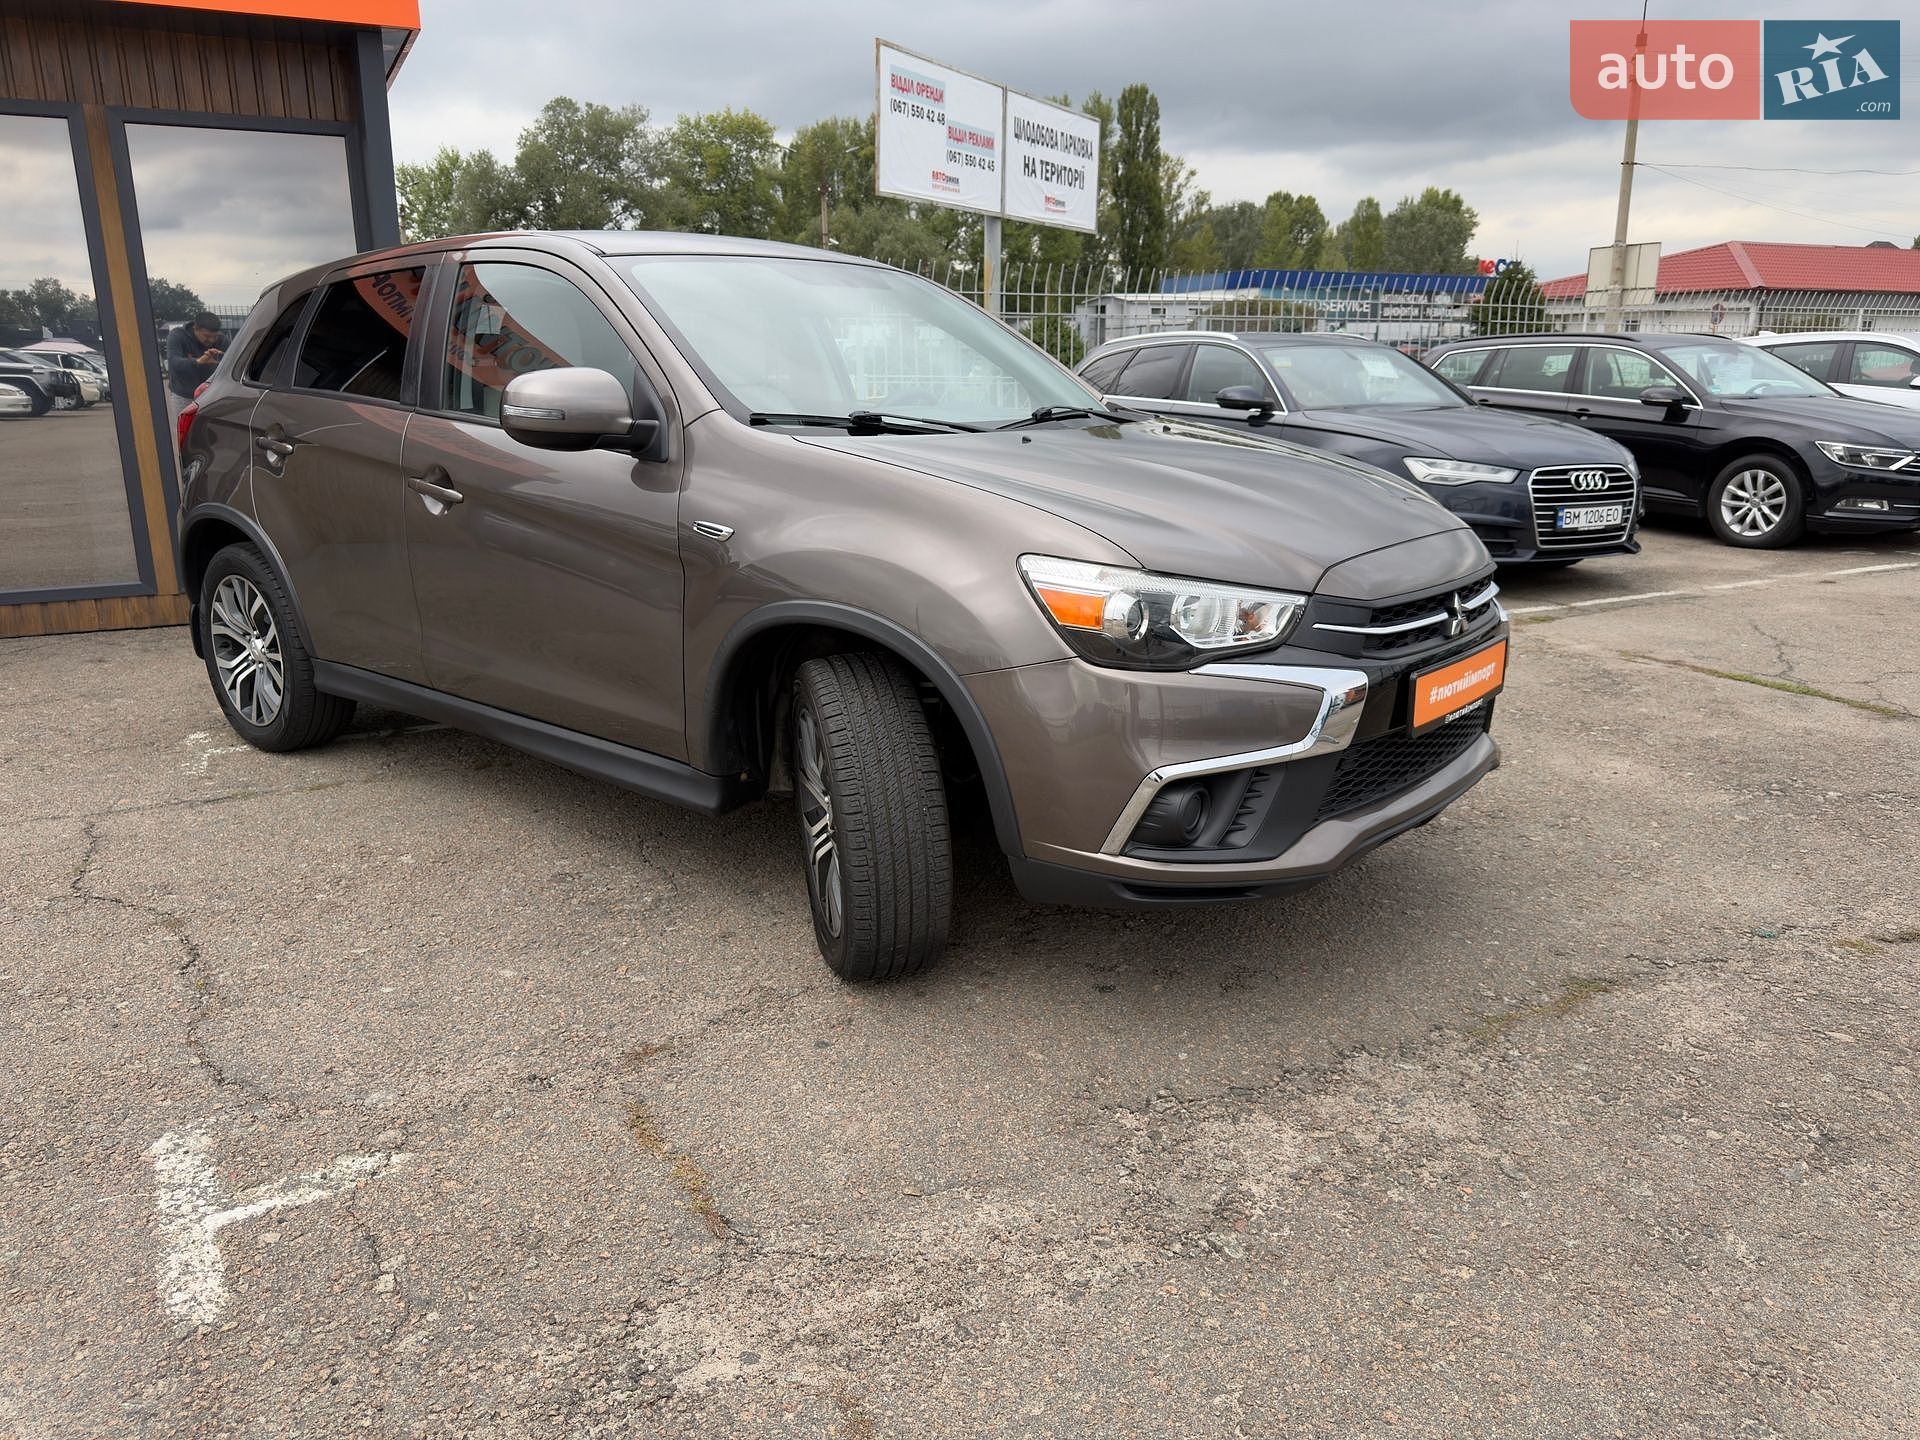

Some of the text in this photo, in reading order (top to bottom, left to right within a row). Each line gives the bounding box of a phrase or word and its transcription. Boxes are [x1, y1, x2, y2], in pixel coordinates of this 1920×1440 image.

[891, 73, 944, 104] ВІДДІЛ ОРЕНДИ
[890, 98, 909, 118] (067)
[911, 104, 925, 120] 550
[926, 109, 935, 122] 42
[946, 148, 964, 167] (067)
[965, 153, 977, 167] 550
[978, 157, 986, 170] 42
[1060, 131, 1094, 161] ПАРКОВКА
[1023, 154, 1085, 191] НА ТЕРИТОРІЇ
[1564, 511, 1581, 526] BM
[1584, 508, 1605, 524] 1206
